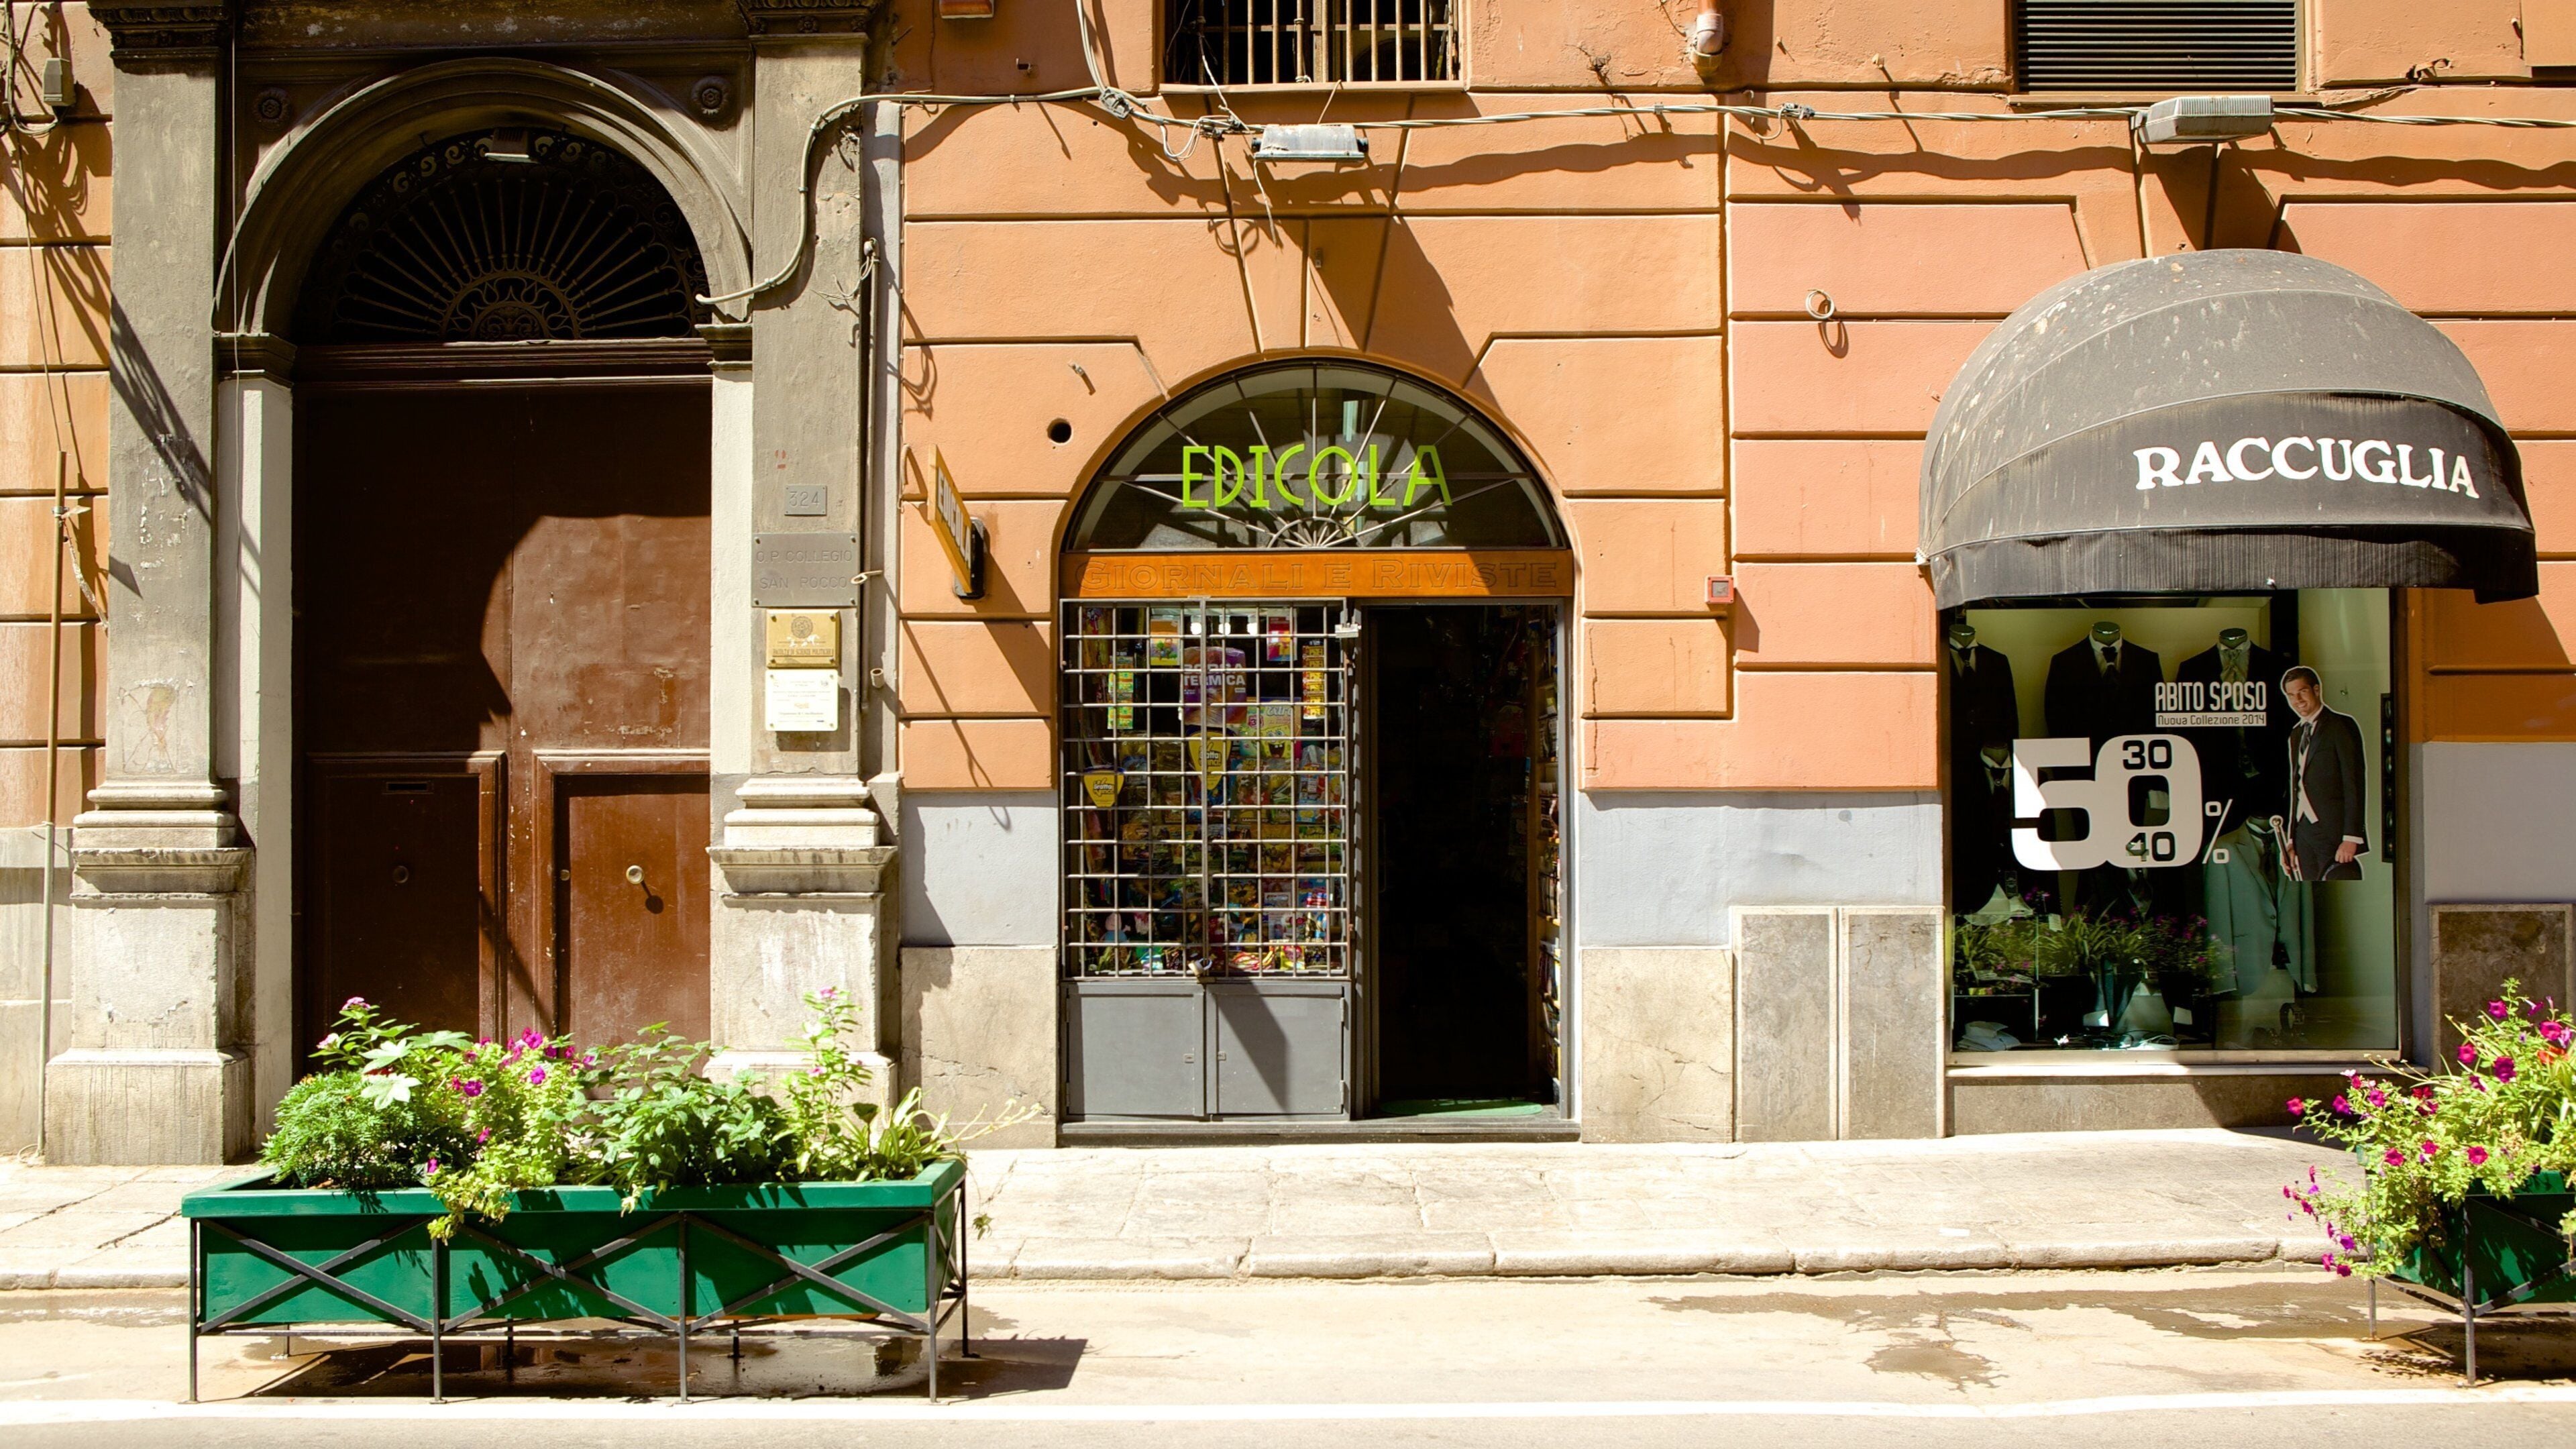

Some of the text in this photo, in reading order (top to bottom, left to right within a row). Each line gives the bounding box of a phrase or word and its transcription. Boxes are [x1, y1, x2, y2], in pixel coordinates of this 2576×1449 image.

[1183, 443, 1452, 508] EDICOLA
[2133, 436, 2480, 498] RACCUGLIA
[789, 491, 820, 508] 324
[786, 550, 853, 563] COLLEGIO
[759, 576, 789, 589] SAN
[1075, 559, 1557, 590] GIORNALI E RIVISTE
[1183, 675, 1246, 686] TEMCA
[2155, 681, 2267, 711] ABITO SPOSO
[2190, 714, 2239, 726] Collezione
[2243, 714, 2265, 724] 2014
[2123, 739, 2172, 770] 30
[2126, 832, 2176, 862] 40
